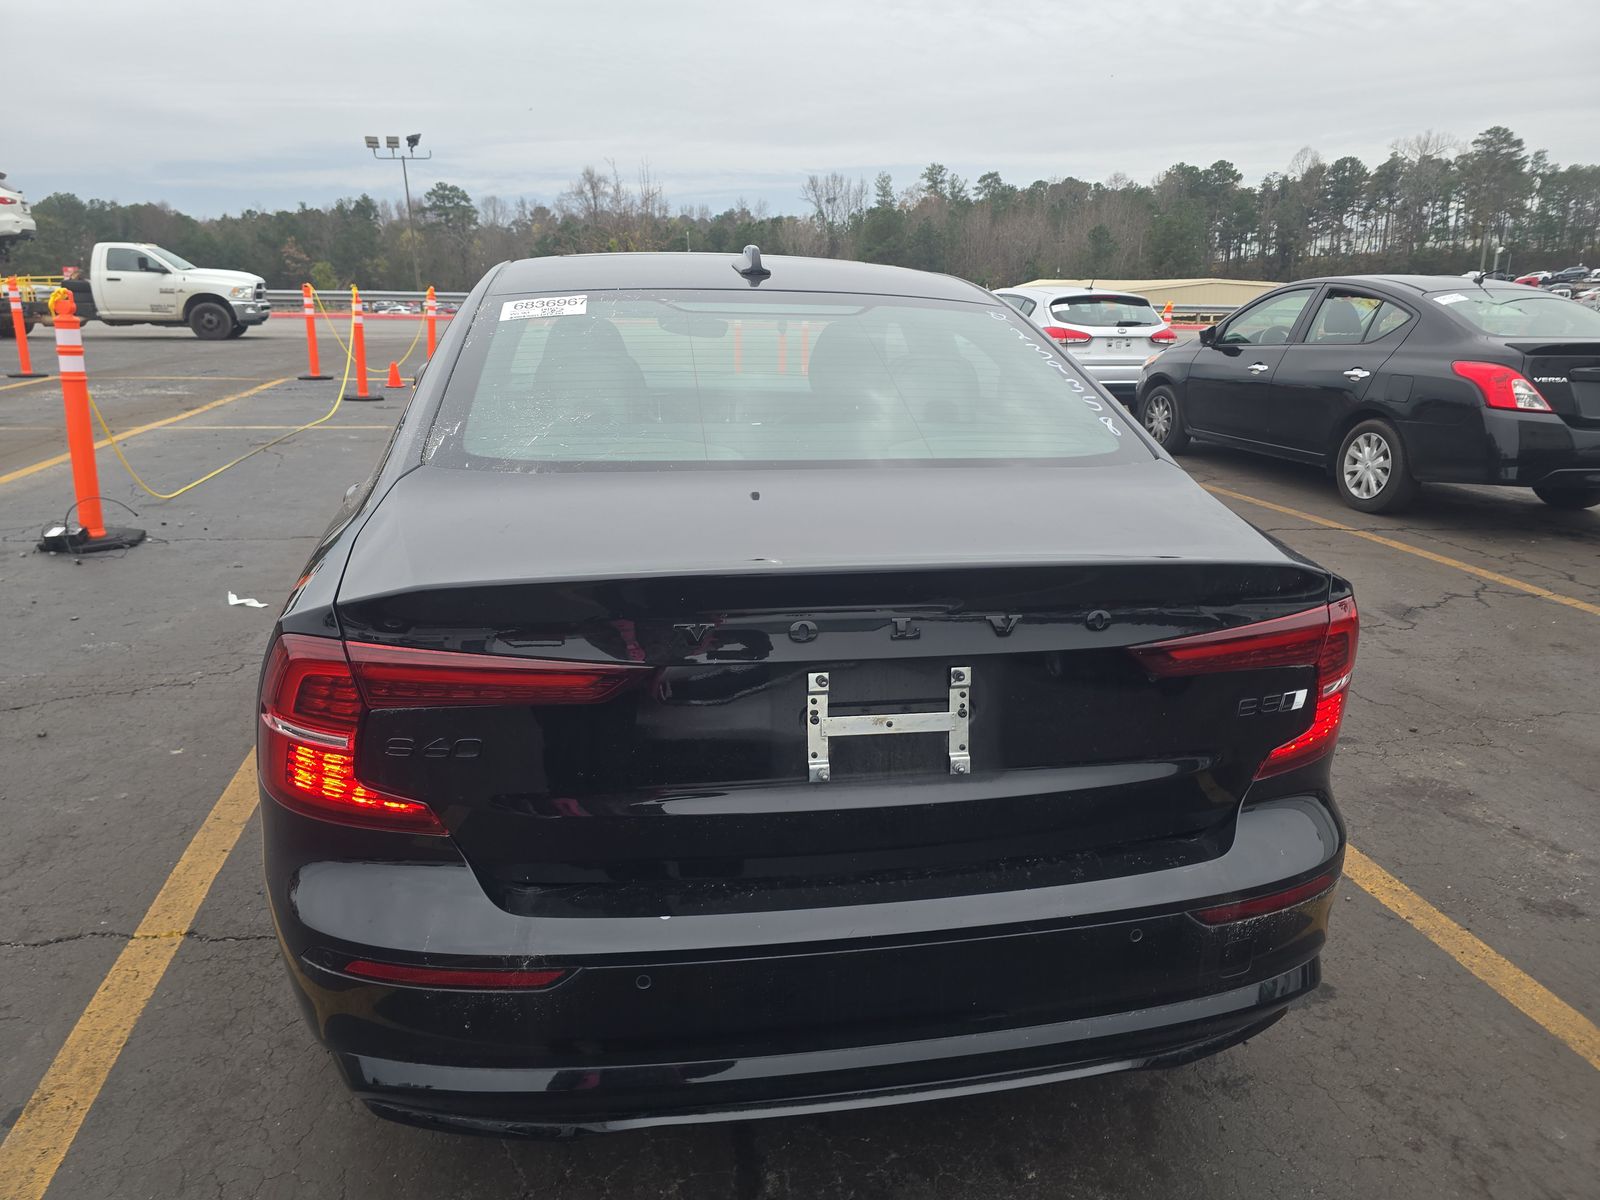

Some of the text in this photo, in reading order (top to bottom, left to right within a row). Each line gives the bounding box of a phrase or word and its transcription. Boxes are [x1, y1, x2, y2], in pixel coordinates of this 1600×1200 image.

[513, 297, 587, 310] 6836967
[673, 608, 1113, 644] VOLVO
[384, 737, 483, 758] S60
